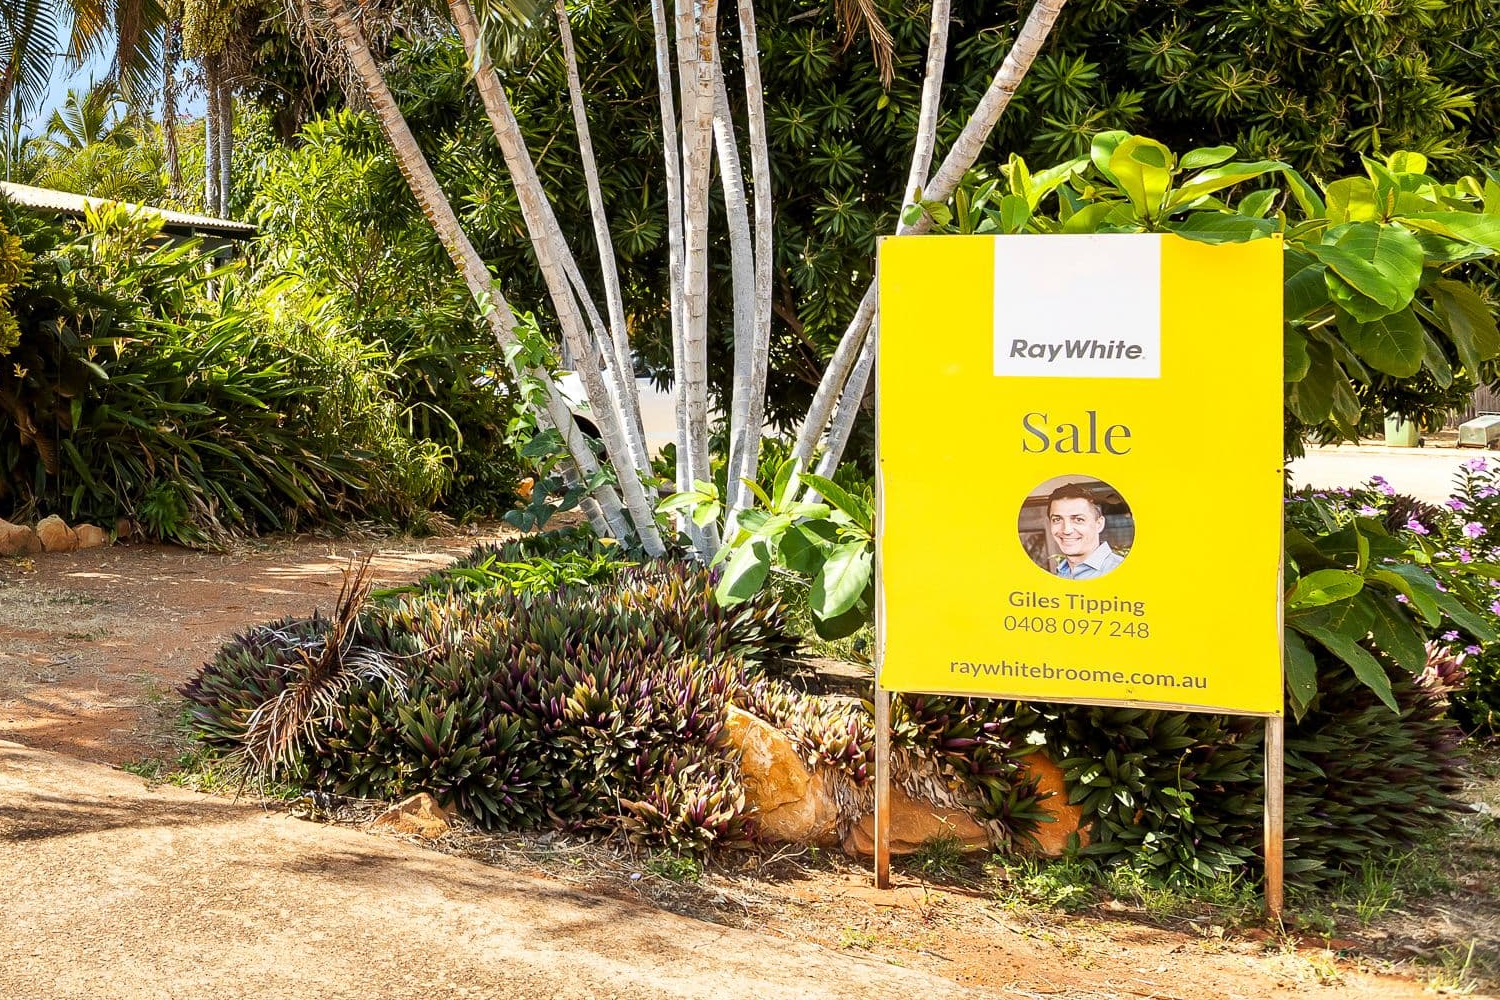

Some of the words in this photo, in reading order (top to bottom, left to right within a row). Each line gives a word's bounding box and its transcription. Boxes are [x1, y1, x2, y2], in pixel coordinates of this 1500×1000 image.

[1022, 410, 1132, 456] Sale
[1009, 591, 1060, 609] Giles
[1065, 593, 1145, 617] Tipping
[1004, 615, 1057, 634] 0408
[1062, 618, 1103, 636] 097
[1109, 621, 1150, 639] 248
[950, 660, 1207, 690] raywhitebroome.com.au
